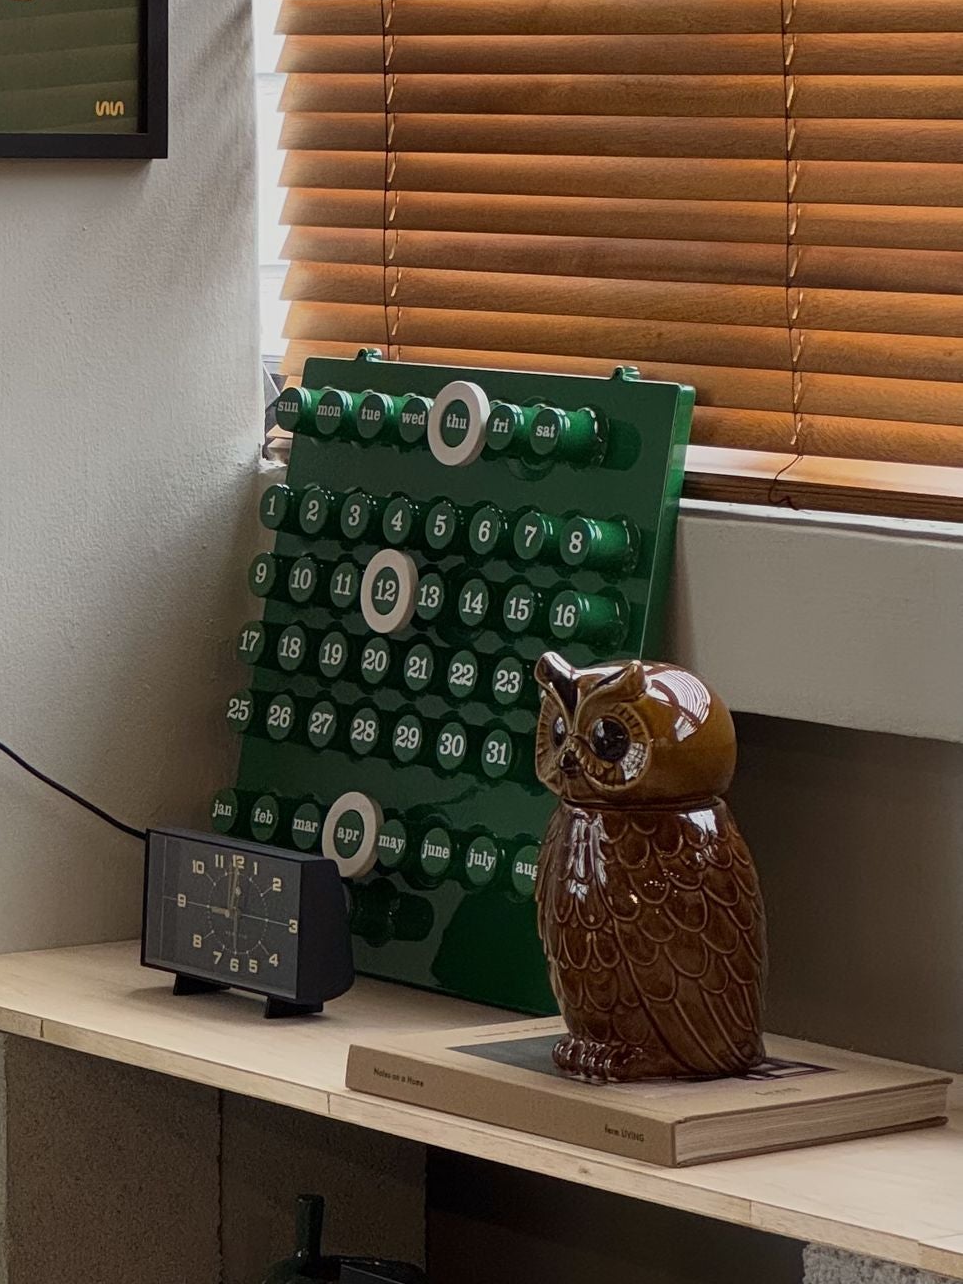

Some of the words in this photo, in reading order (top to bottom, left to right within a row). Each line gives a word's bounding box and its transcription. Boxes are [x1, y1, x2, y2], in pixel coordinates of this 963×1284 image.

[277, 401, 298, 413] sun
[317, 405, 340, 417] mon
[361, 406, 381, 421] tue
[401, 410, 426, 426] wed
[446, 413, 467, 430] thu
[492, 417, 510, 433] fri
[535, 423, 556, 438] sat
[266, 495, 276, 516] 1
[306, 499, 319, 522] 2
[348, 504, 361, 526] 3
[391, 509, 403, 532] 4
[433, 514, 447, 536] 5
[478, 520, 491, 543] 6
[524, 524, 538, 547] 7
[568, 531, 583, 554] 8
[255, 562, 267, 584] 9
[291, 567, 312, 590] 10
[334, 572, 352, 596] 11
[374, 579, 397, 602] 12
[417, 584, 440, 608] 13
[462, 590, 483, 615] 14
[507, 597, 531, 621] 15
[553, 603, 576, 628] 16
[239, 629, 261, 652] 17
[279, 635, 301, 659] 18
[321, 642, 343, 665] 19
[362, 648, 387, 672] 20
[406, 656, 428, 680] 21
[449, 662, 475, 687] 22
[494, 669, 521, 694] 23
[226, 698, 251, 721] 25
[267, 704, 292, 728] 26
[309, 711, 334, 735] 27
[351, 718, 376, 742] 28
[394, 725, 420, 749] 29
[439, 732, 465, 757] 30
[485, 740, 507, 765] 31
[212, 799, 232, 818] jan
[253, 807, 274, 825] feb
[292, 818, 319, 833] mar
[336, 826, 360, 844] apr
[377, 835, 405, 854] may
[421, 839, 450, 859] june
[467, 848, 496, 872] july
[192, 860, 205, 874] 10
[215, 854, 224, 869] 11
[232, 854, 245, 869] 12
[253, 862, 258, 875] 1
[272, 877, 282, 892] 2
[177, 894, 187, 908] 9
[288, 919, 298, 934] 3
[193, 934, 202, 948] 8
[212, 951, 223, 964] 7
[268, 953, 278, 967] 4
[229, 958, 239, 973] 6
[248, 959, 258, 973] 5
[373, 1067, 391, 1079] Notes
[407, 1075, 424, 1087] Home
[621, 1128, 645, 1142] LIVING
